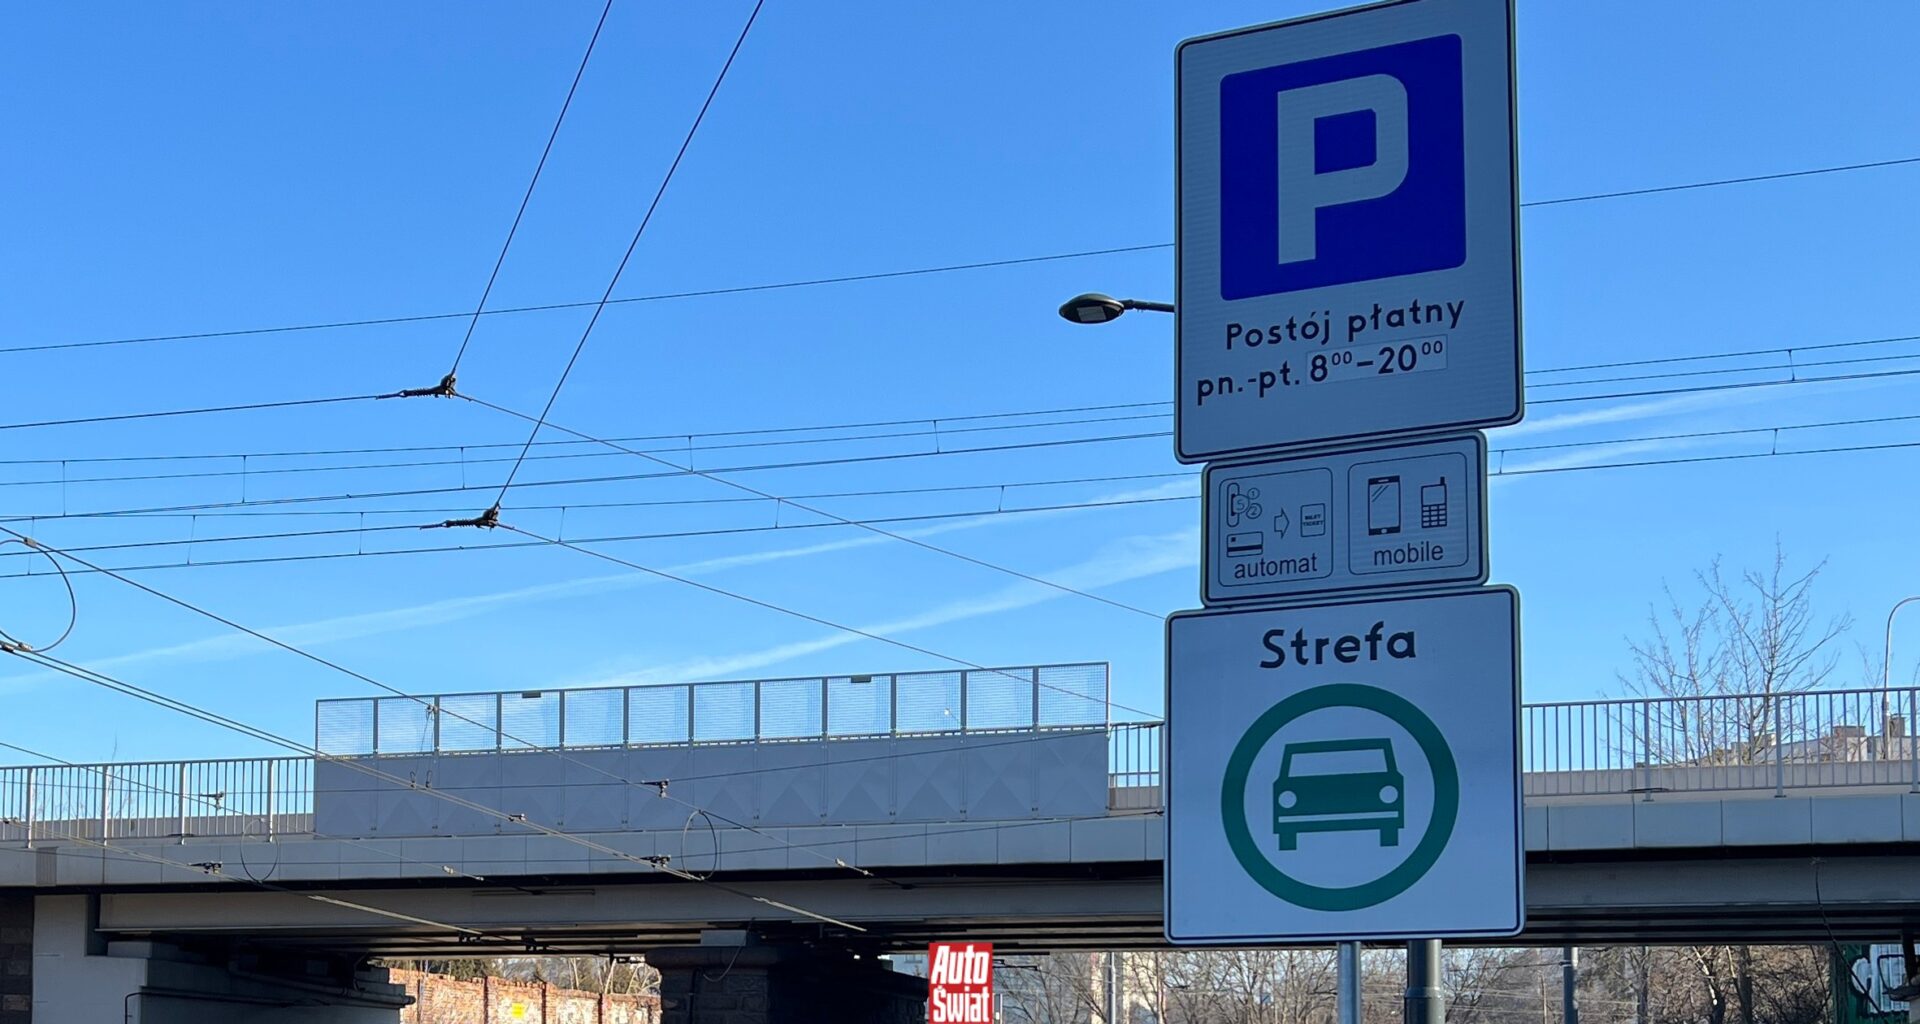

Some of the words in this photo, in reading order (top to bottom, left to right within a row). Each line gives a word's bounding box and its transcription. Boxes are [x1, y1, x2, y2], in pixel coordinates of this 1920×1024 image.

[1278, 73, 1409, 265] P
[1226, 310, 1331, 350] Postój
[1349, 300, 1465, 343] płatny
[1197, 361, 1301, 406] pn.-pt.
[1233, 552, 1318, 580] automat
[1373, 540, 1445, 566] mobile
[1259, 620, 1417, 669] Strefa
